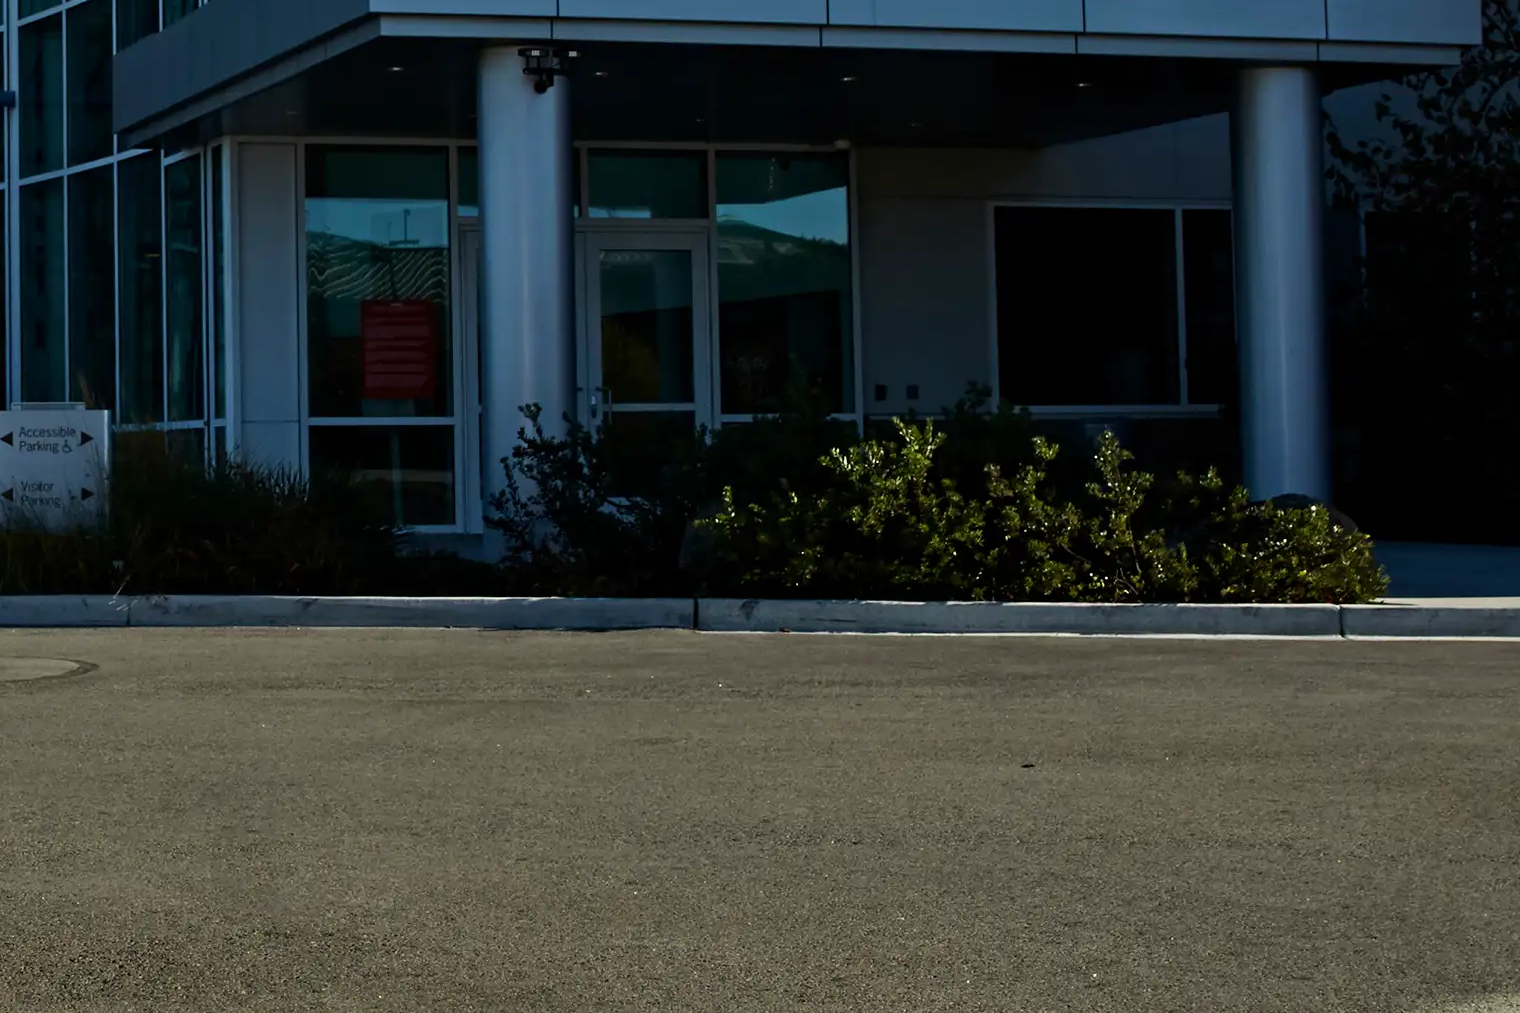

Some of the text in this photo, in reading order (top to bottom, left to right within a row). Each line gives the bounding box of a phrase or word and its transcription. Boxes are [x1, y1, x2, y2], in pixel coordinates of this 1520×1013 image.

[18, 426, 77, 439] Accessible
[19, 440, 60, 454] Parking
[20, 480, 54, 492] Visitor
[21, 495, 61, 508] Parking
